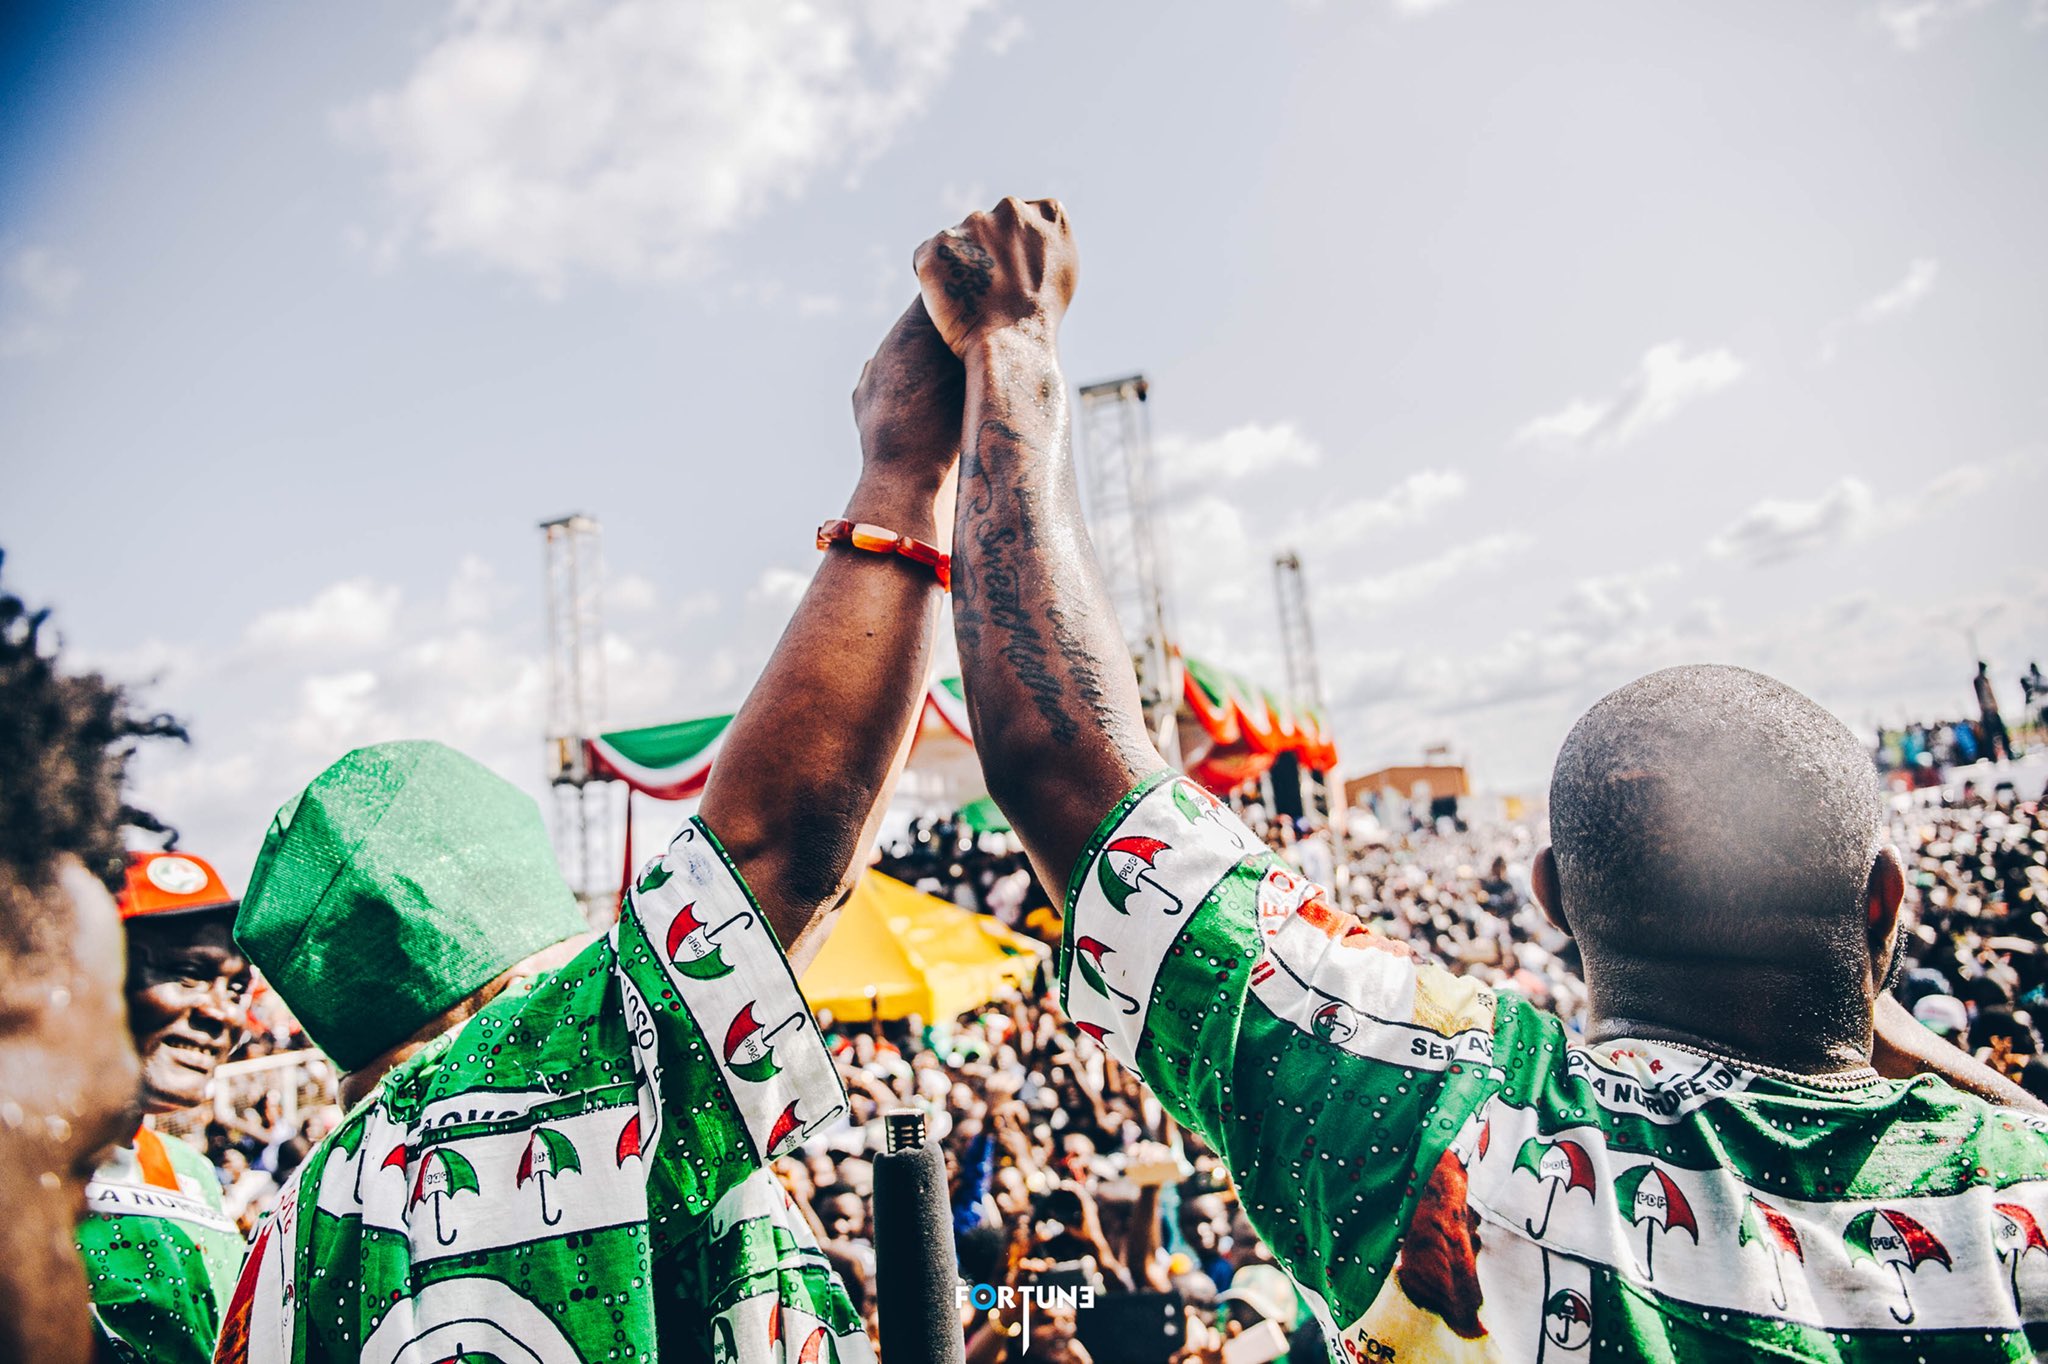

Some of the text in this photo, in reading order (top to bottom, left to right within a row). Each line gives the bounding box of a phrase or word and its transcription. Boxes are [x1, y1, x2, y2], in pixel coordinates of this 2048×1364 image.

[1119, 855, 1138, 881] PDP
[1637, 1191, 1668, 1209] PDP
[1872, 1236, 1903, 1251] PDP
[1358, 1327, 1396, 1364] FOR
